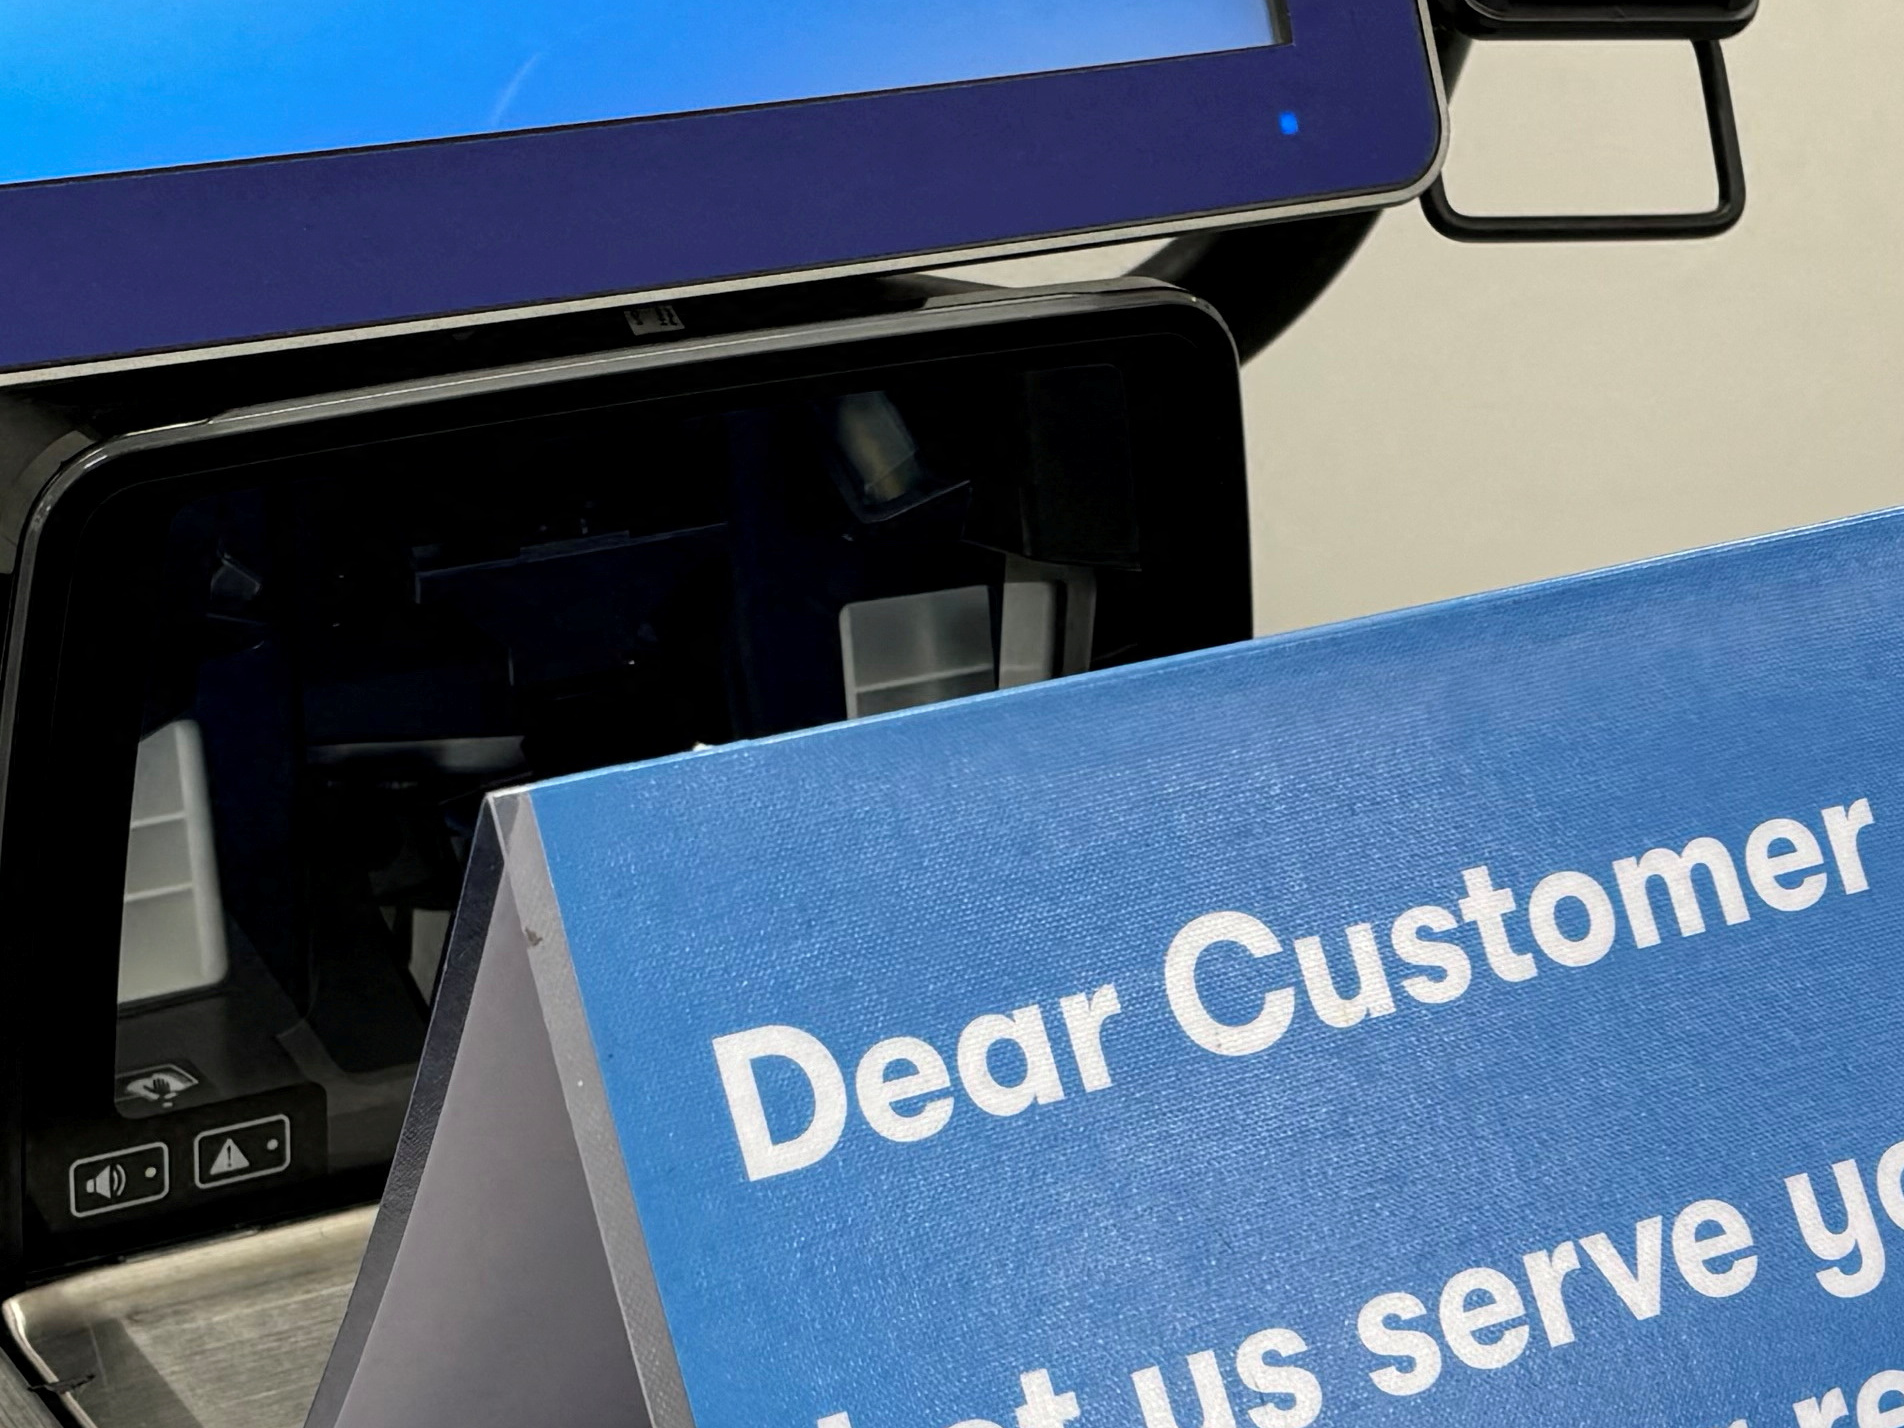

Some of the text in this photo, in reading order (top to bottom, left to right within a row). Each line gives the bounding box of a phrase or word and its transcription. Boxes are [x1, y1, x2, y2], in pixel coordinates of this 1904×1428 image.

[710, 798, 1875, 1183] Dear Customer
[1354, 1197, 1759, 1398] serve
